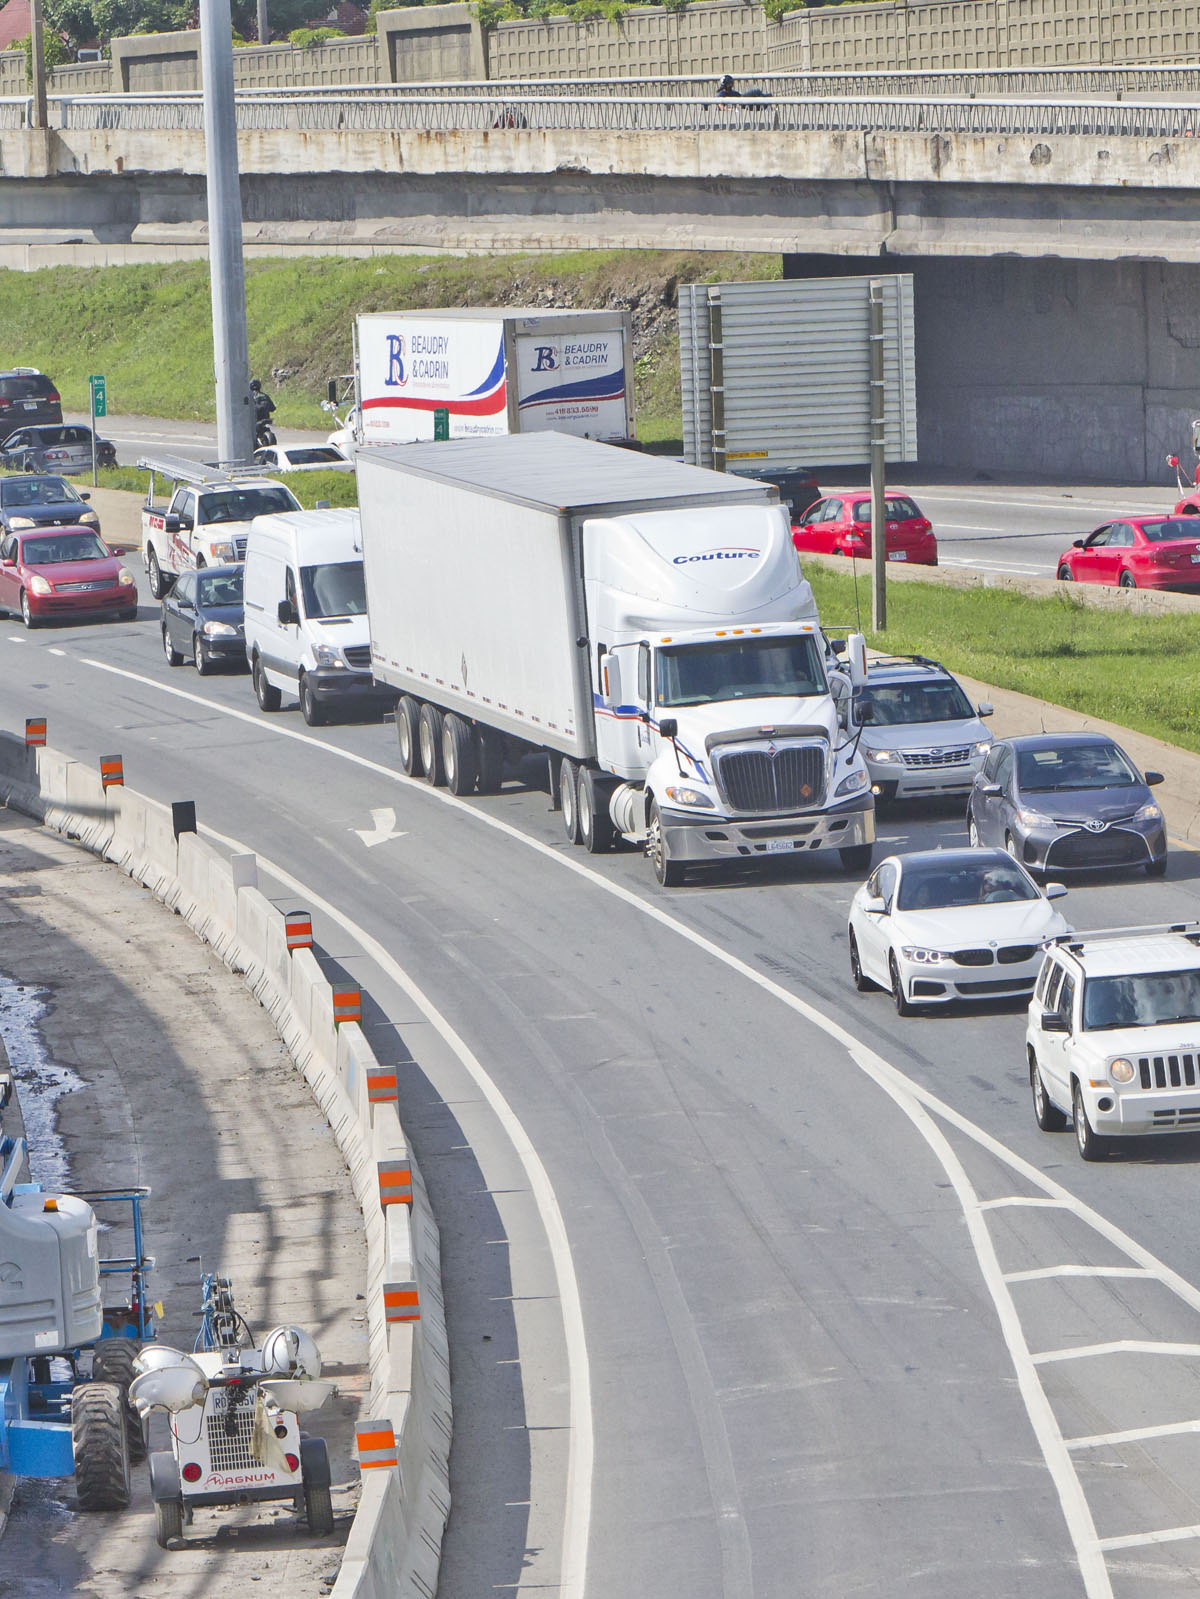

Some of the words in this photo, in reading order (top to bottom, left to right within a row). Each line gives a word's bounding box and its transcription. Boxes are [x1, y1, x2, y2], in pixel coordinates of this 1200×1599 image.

[411, 335, 449, 355] BEAUDRY
[564, 342, 608, 354] BEAUDRY
[572, 354, 608, 365] CADRIN
[96, 391, 104, 401] 4
[673, 551, 760, 565] Couture
